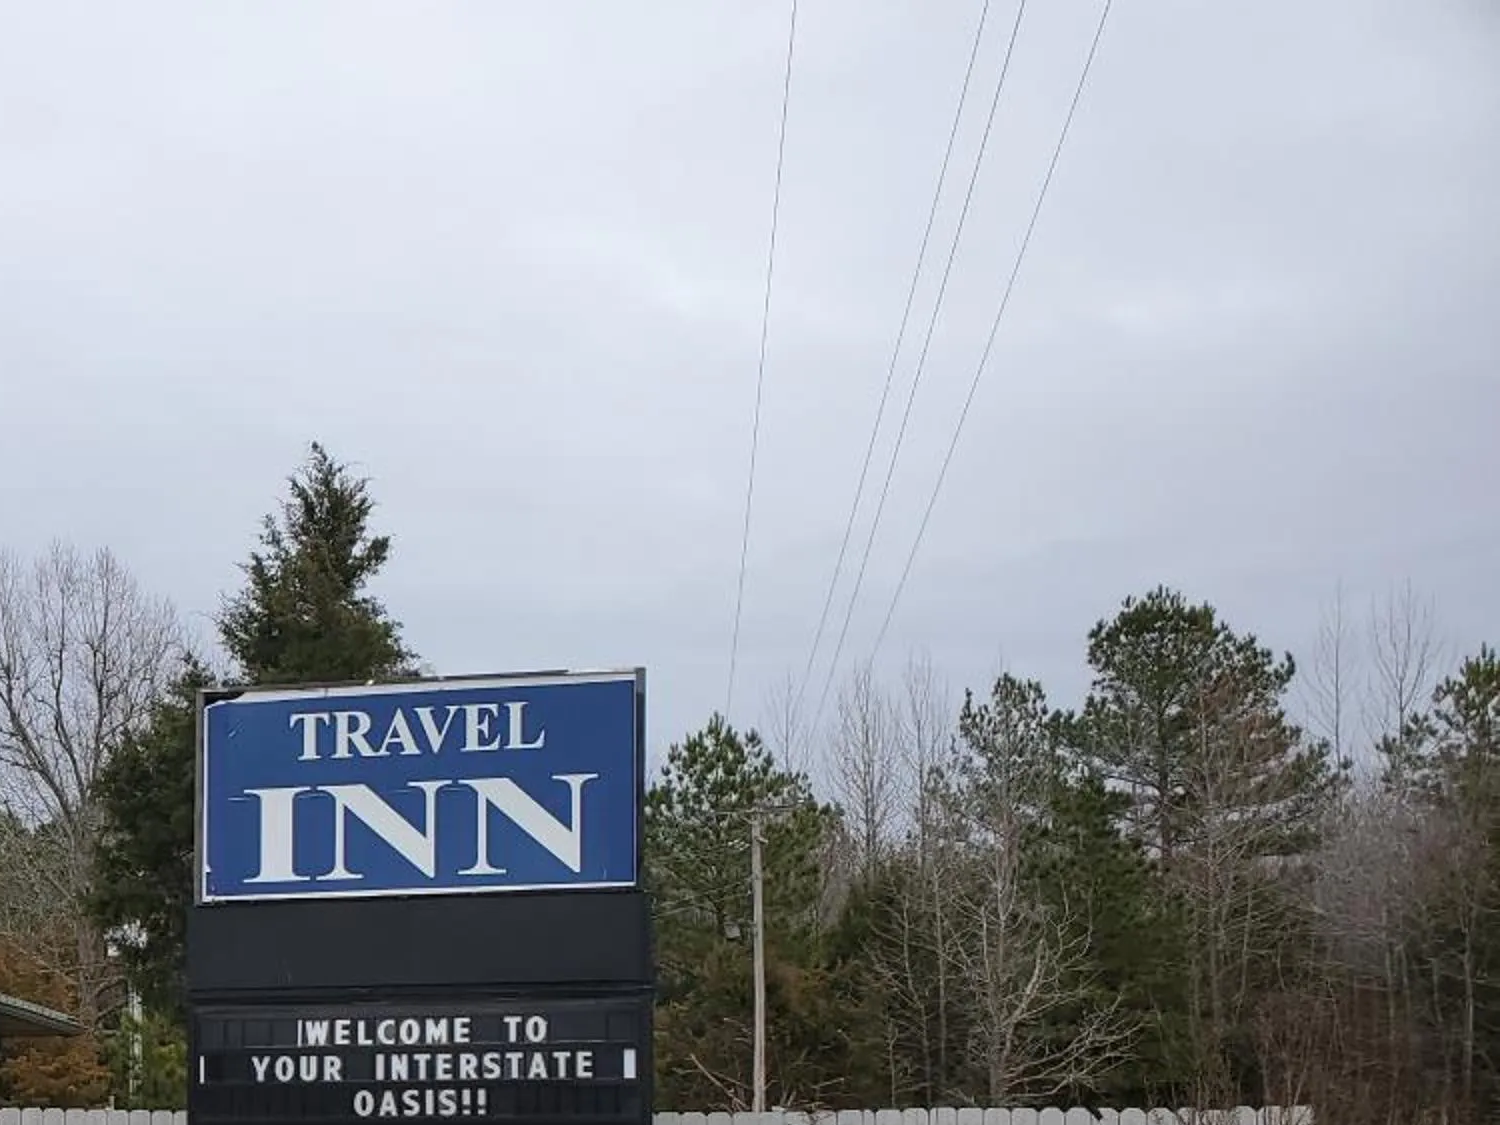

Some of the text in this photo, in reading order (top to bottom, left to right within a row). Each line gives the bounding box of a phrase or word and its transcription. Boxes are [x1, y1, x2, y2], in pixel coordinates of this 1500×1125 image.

[290, 702, 546, 761] TRAVEL
[243, 773, 599, 884] INN
[304, 1015, 548, 1046] WELCOME TO
[251, 1051, 595, 1082] YOUR INTERSTATE
[353, 1089, 487, 1117] OASIS!!
